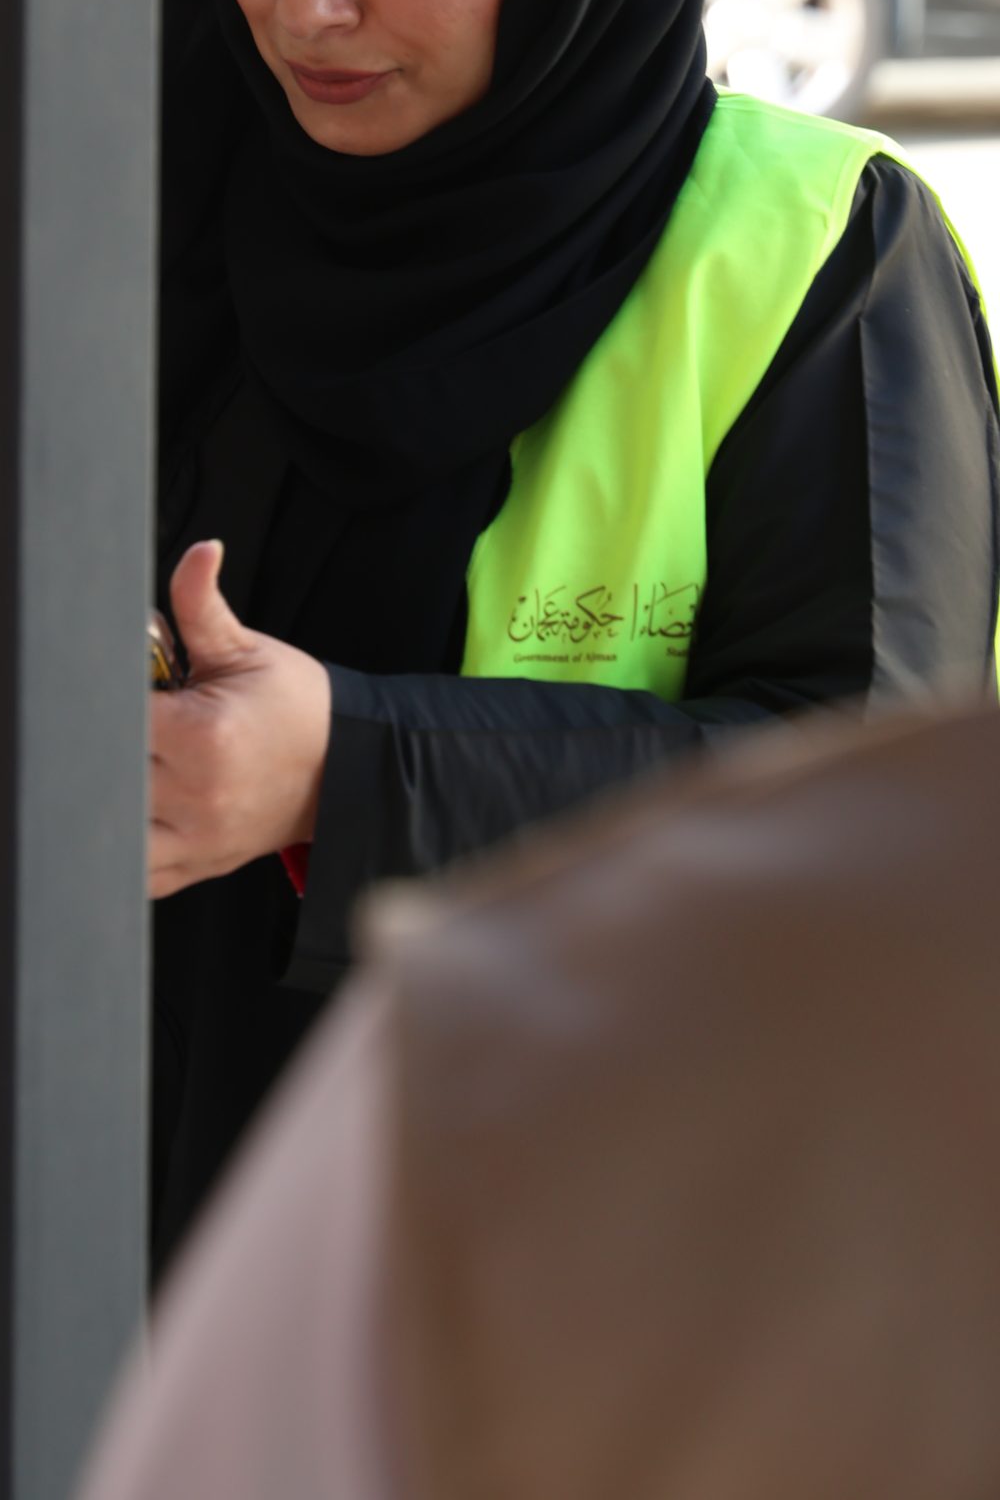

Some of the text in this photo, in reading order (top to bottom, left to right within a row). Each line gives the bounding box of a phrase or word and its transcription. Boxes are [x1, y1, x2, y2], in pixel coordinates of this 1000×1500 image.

[513, 651, 618, 664] Government of Ajman
